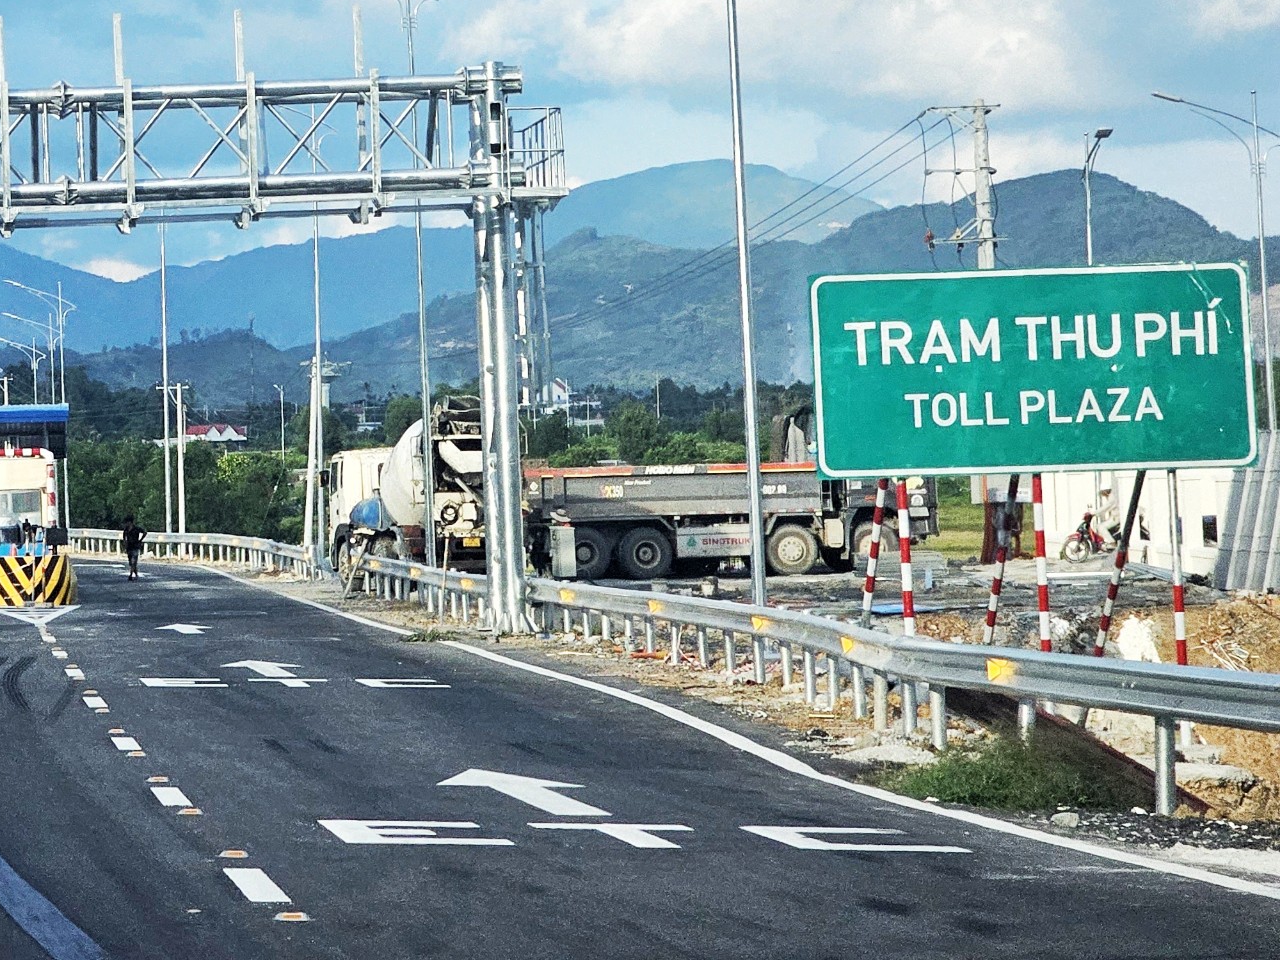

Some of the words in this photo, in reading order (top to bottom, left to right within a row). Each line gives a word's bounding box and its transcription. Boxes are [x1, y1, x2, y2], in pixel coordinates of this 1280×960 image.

[843, 317, 1001, 373] TRẠM
[1134, 297, 1223, 357] PHÍ
[904, 391, 1010, 429] TOLL
[1020, 386, 1164, 425] PLAZA
[702, 537, 751, 546] SINOTRUK
[128, 677, 452, 688] ETC
[316, 819, 973, 852] ETC
